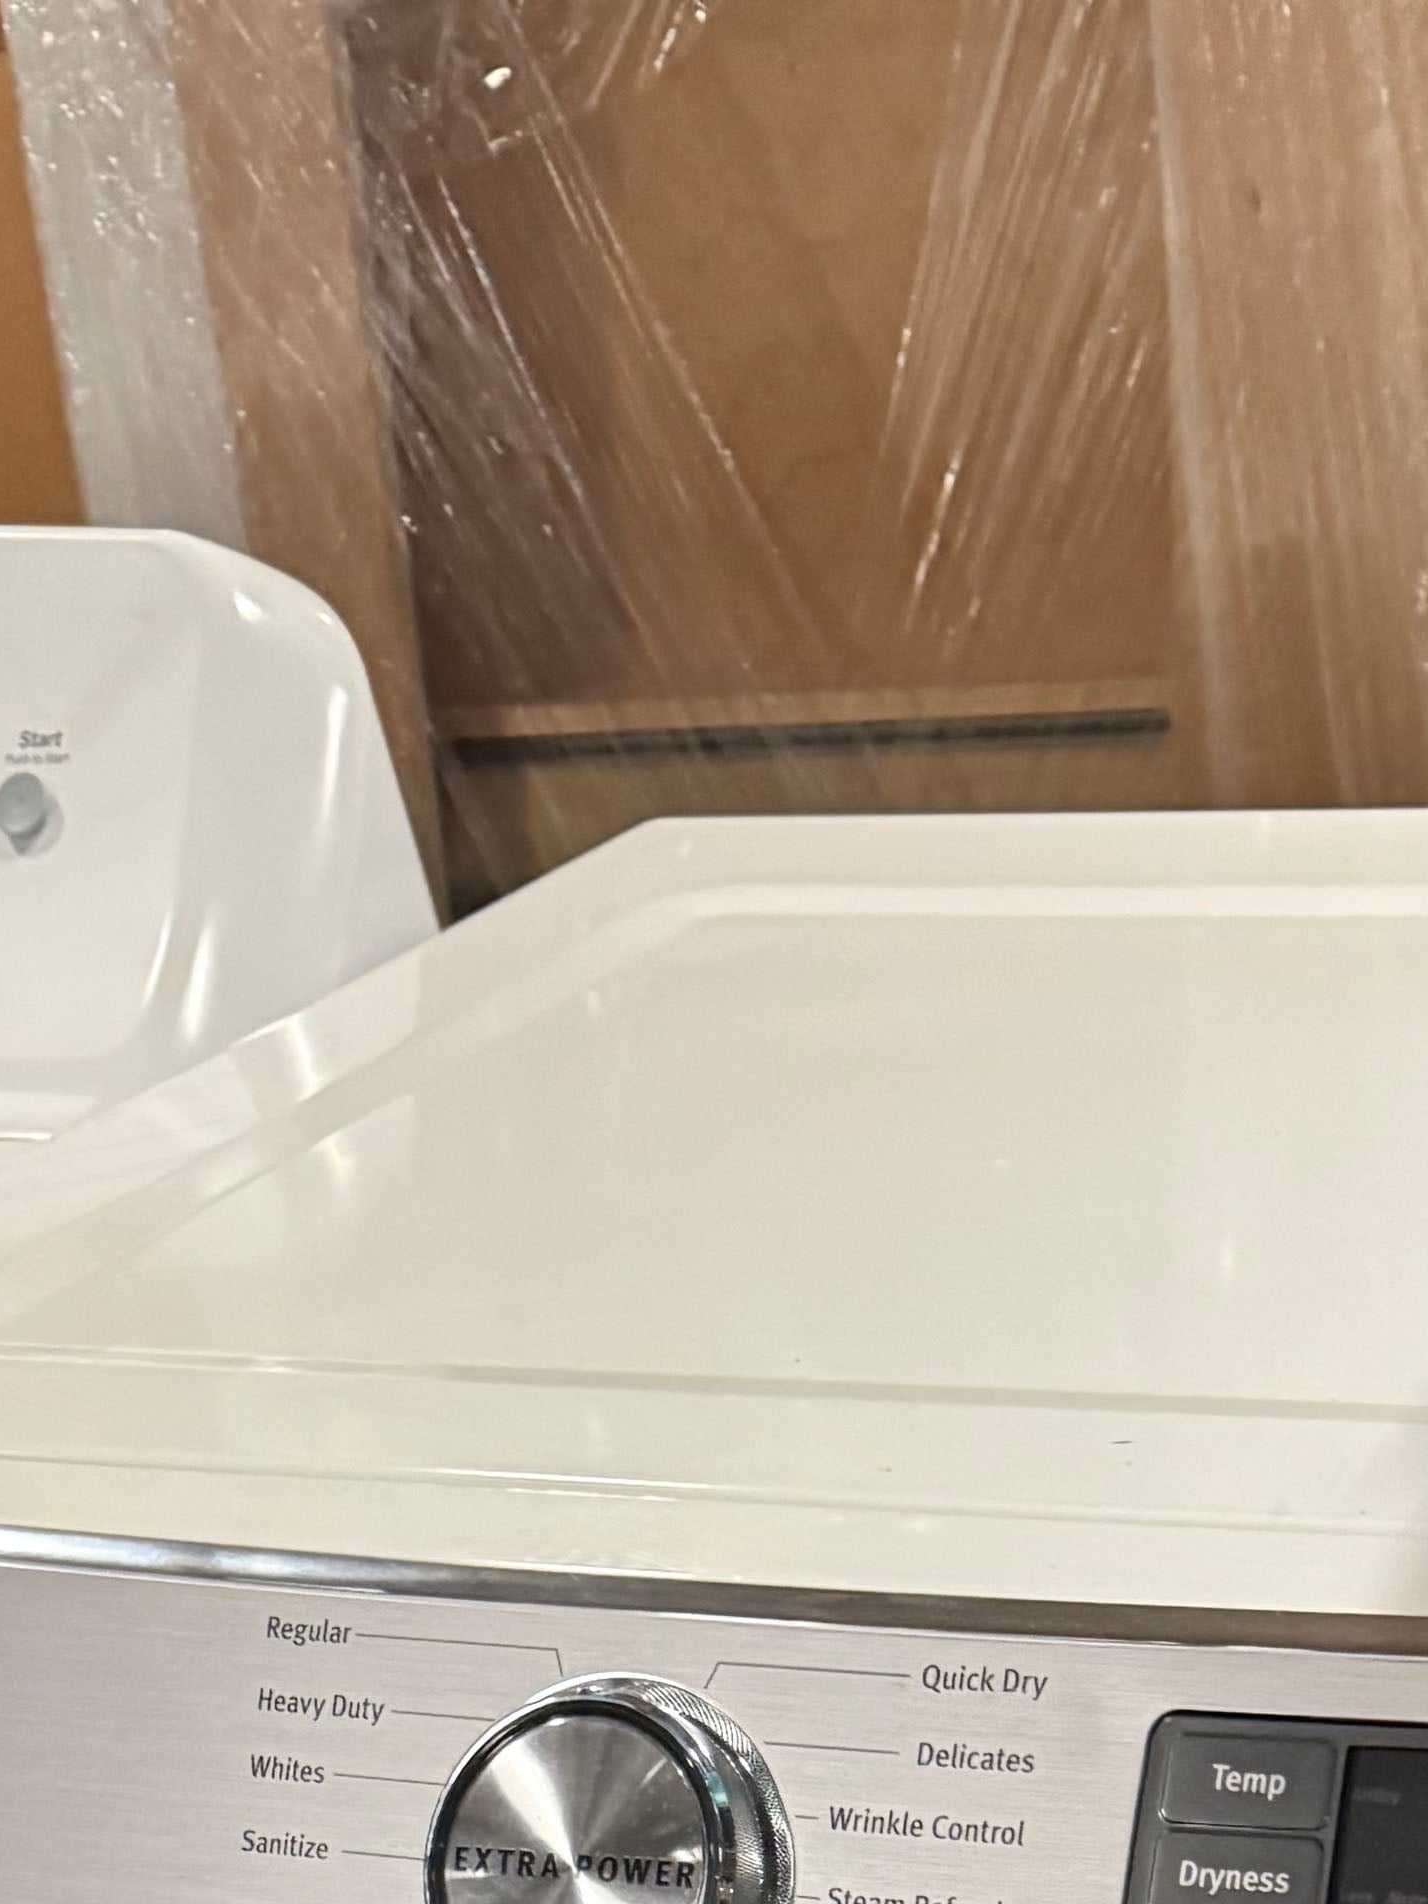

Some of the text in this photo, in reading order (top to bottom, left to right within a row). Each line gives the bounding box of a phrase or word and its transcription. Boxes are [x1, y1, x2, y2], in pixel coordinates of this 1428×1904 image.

[18, 730, 63, 748] Start
[266, 1616, 352, 1646] Regular
[922, 1664, 1049, 1701] Quick Dry
[257, 1688, 385, 1726] Heavy Duty
[250, 1754, 325, 1783] Whites
[916, 1742, 1035, 1773] Delicates
[1212, 1763, 1286, 1800] Temp
[241, 1829, 329, 1859] Sanitize
[829, 1806, 1025, 1847] Wrinkle Control
[454, 1846, 696, 1890] EXTRA POWER
[1178, 1860, 1290, 1896] Dryness
